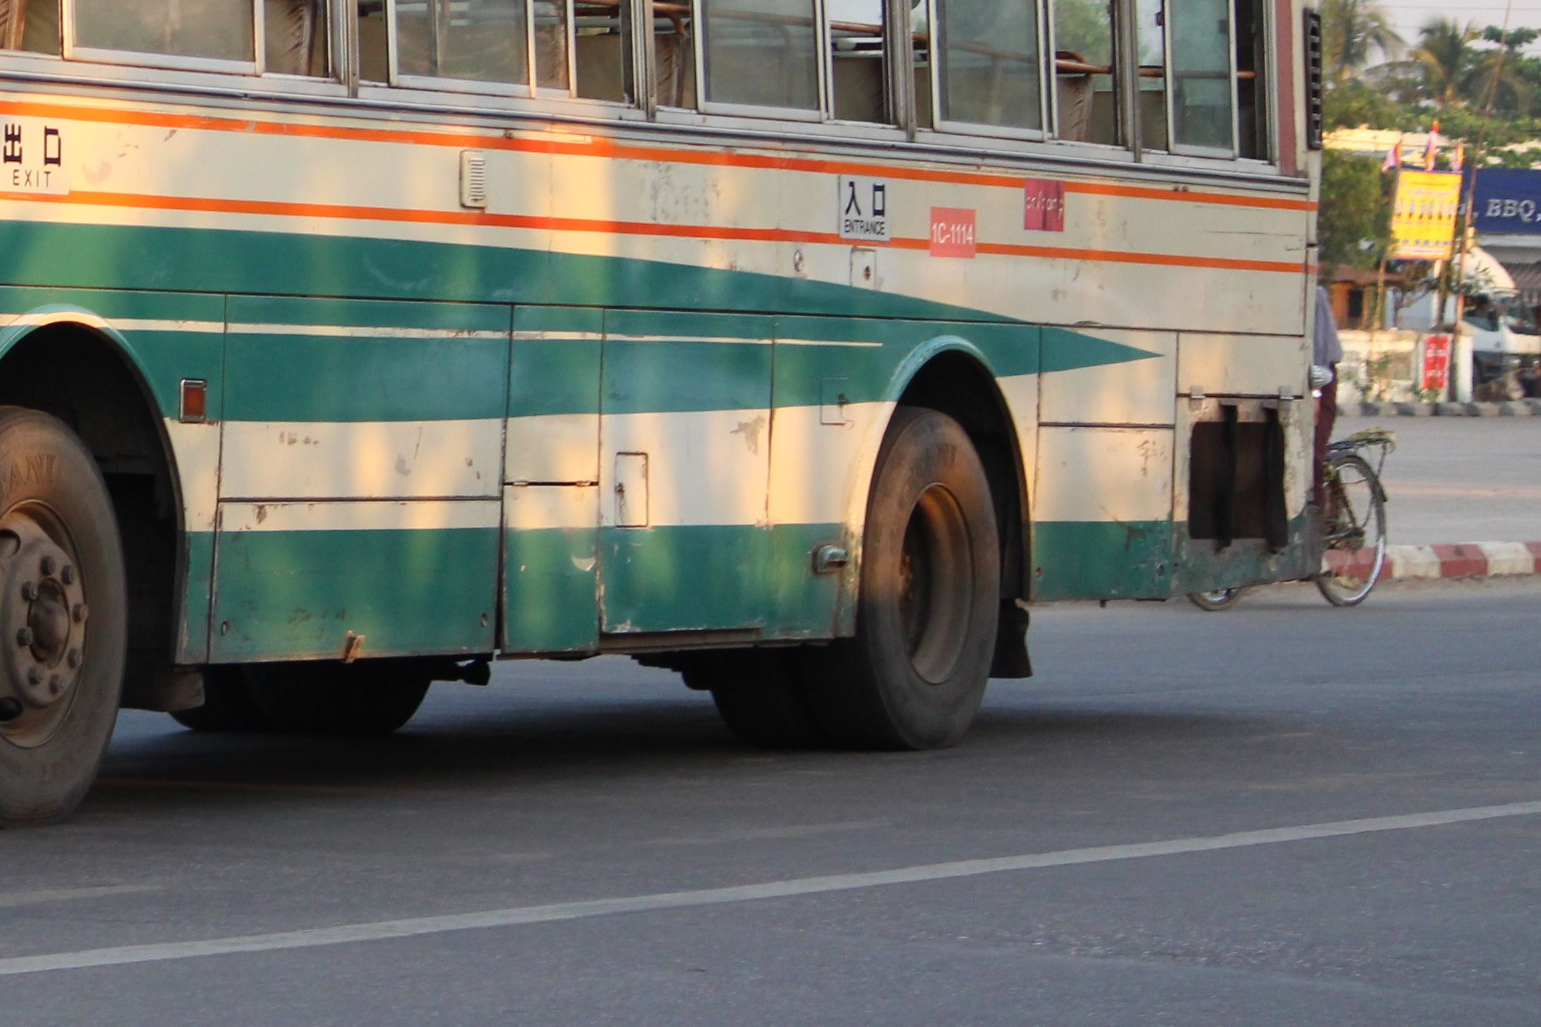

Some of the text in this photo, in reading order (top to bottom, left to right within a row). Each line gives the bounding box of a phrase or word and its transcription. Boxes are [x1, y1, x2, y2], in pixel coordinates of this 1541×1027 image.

[3, 123, 61, 167] 出口
[12, 169, 51, 187] EXIT
[845, 181, 885, 217] 入口
[844, 219, 885, 235] ENTRANCE
[931, 222, 974, 244] 1C-1114
